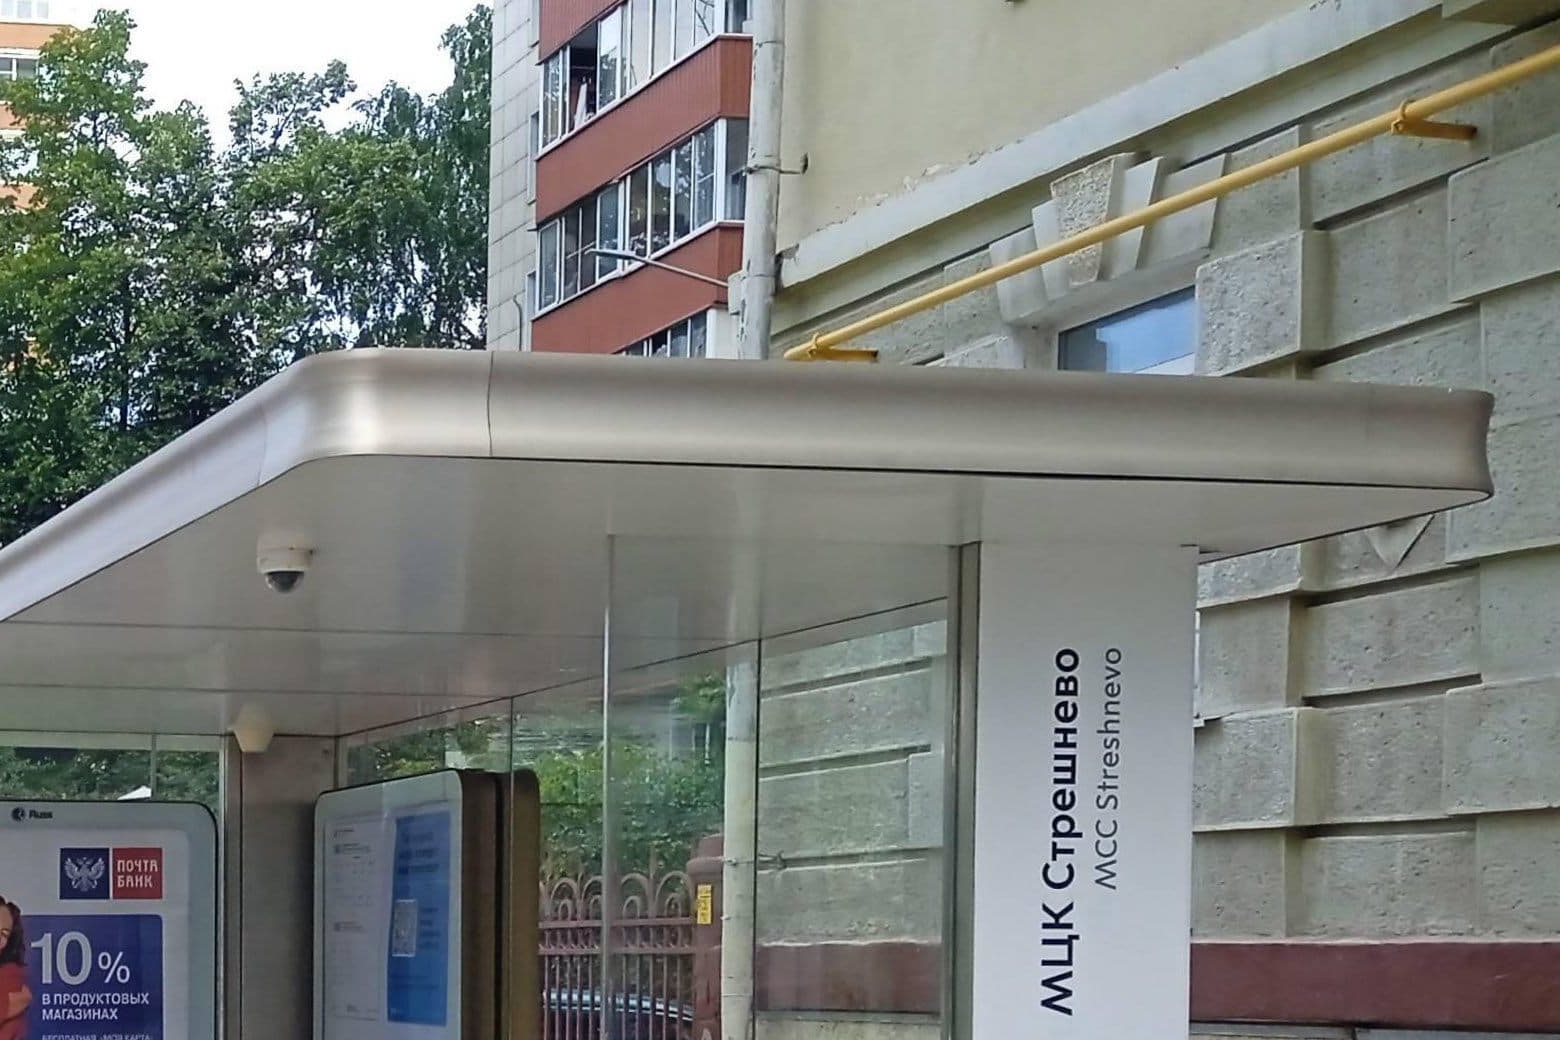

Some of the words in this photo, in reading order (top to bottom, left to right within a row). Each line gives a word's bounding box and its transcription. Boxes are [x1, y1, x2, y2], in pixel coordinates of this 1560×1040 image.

[1096, 647, 1122, 811] Streshnevo
[1042, 648, 1083, 890] Стрешнево
[117, 860, 158, 873] ПОЧТА
[1095, 819, 1118, 890] MCC
[117, 875, 153, 888] БАНК
[1041, 901, 1079, 1016] МЦК
[42, 993, 51, 1005] В
[54, 992, 149, 1007] ПРОДУКТОВЫХ
[42, 1008, 118, 1020] МАГАЗИНАХ
